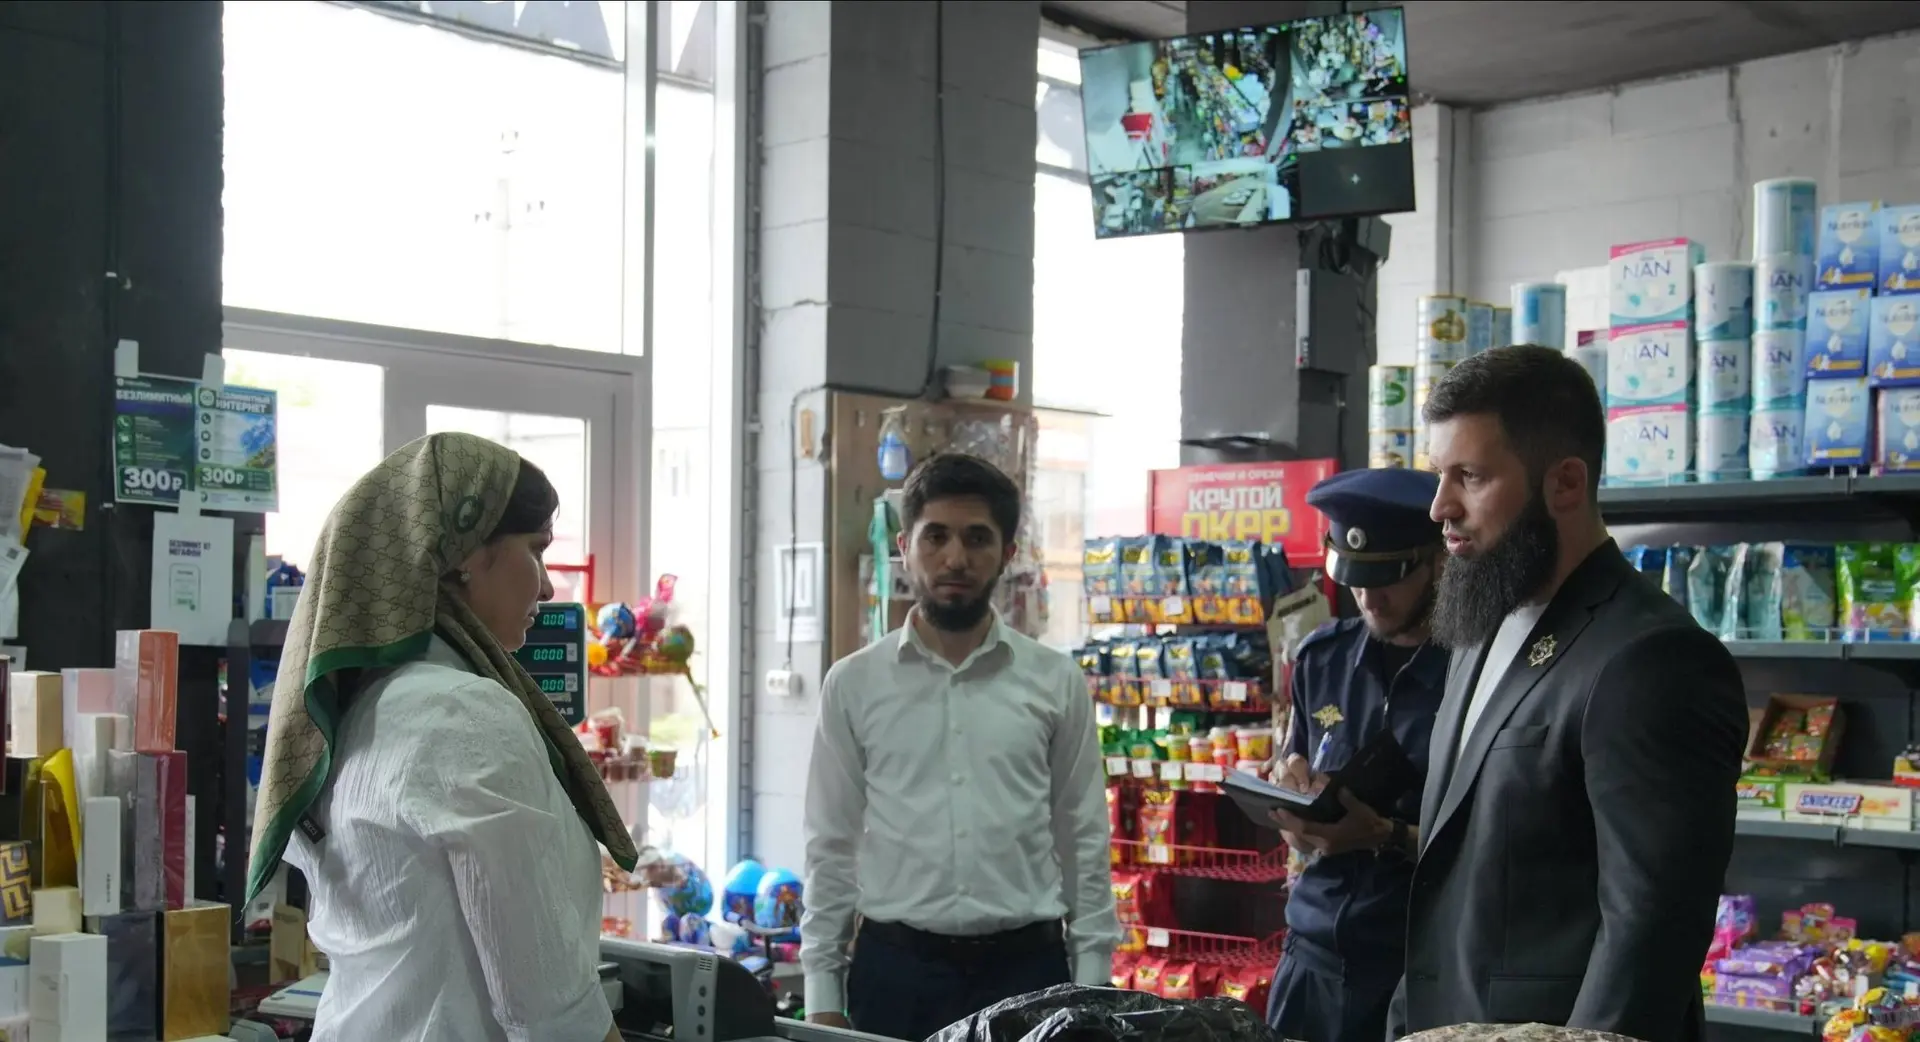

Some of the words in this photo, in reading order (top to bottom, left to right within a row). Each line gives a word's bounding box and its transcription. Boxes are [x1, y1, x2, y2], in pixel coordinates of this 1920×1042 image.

[1623, 260, 1670, 280] NAN
[1668, 284, 1676, 296] 2
[116, 389, 193, 404] БЕЗЛИМИТНЫЙ
[216, 399, 267, 413] ИНТЕРНЕТ
[1188, 482, 1282, 511] КРУТОЙ
[557, 707, 574, 716] AS
[1799, 794, 1856, 809] SNICKERS
